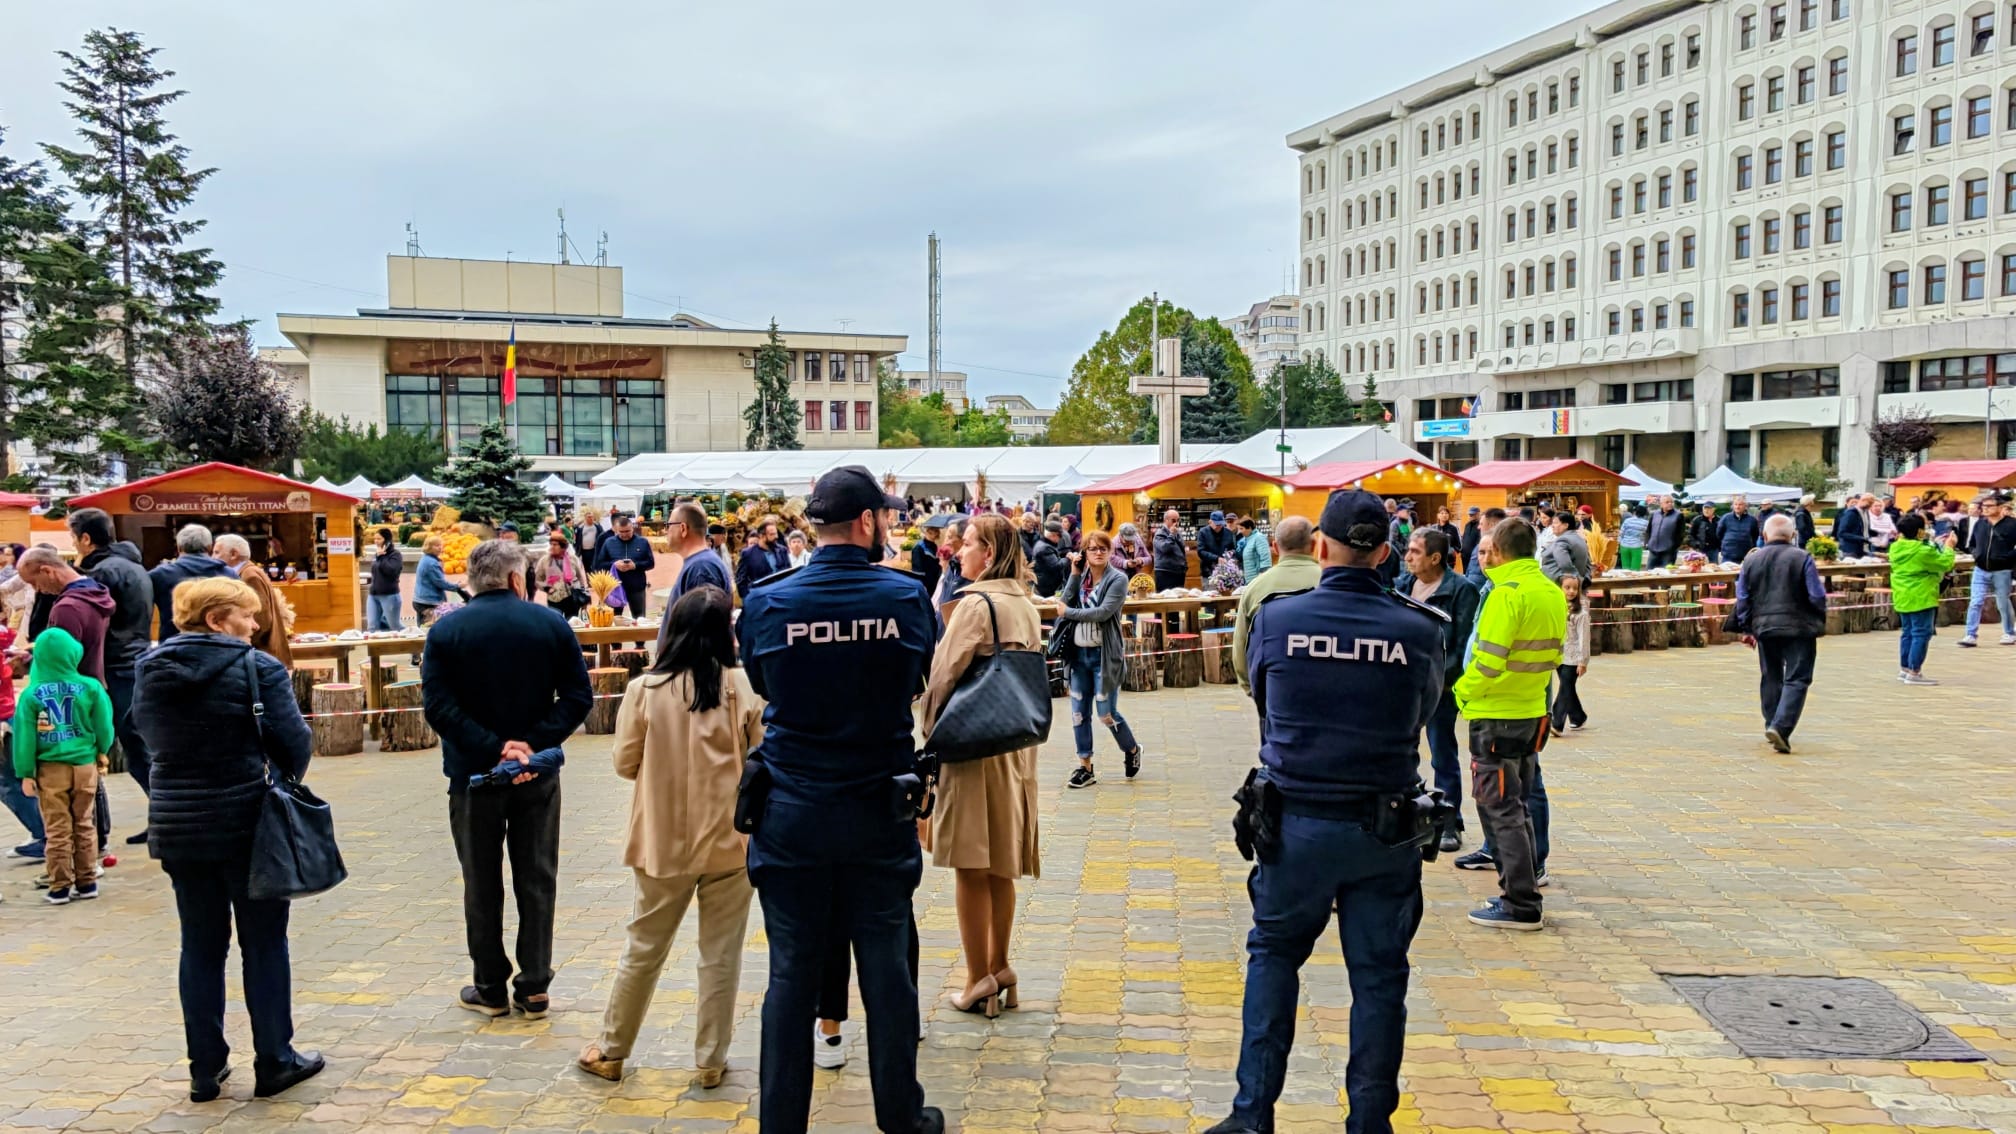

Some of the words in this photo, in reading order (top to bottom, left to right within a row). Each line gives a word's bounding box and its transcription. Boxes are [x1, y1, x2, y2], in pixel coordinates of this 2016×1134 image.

[156, 502, 199, 511] CRAMELE
[258, 502, 286, 511] TITAN
[787, 617, 900, 646] POLITIA
[1287, 634, 1408, 665] POLITIA
[41, 695, 76, 727] M
